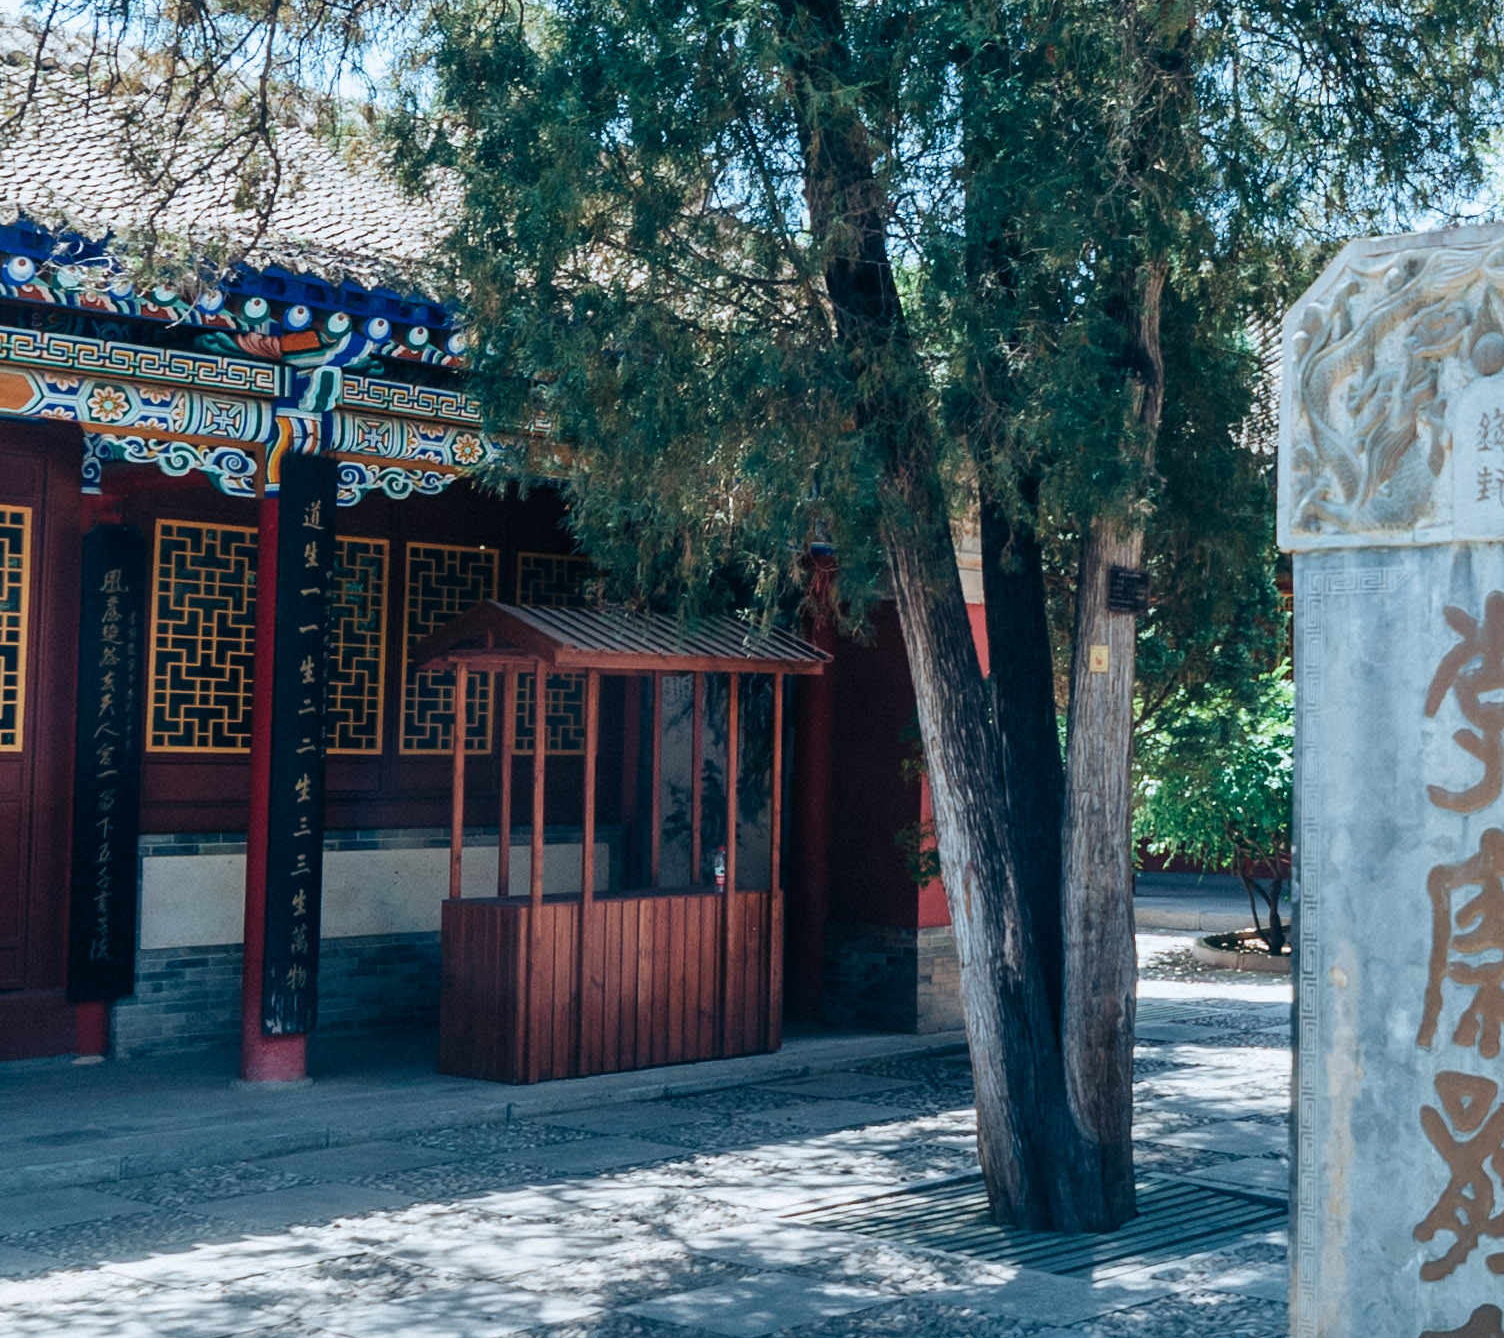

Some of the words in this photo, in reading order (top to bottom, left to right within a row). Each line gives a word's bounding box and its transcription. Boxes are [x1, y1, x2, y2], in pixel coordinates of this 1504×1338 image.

[286, 499, 325, 990] 道生一一生二二生三三生萬物
